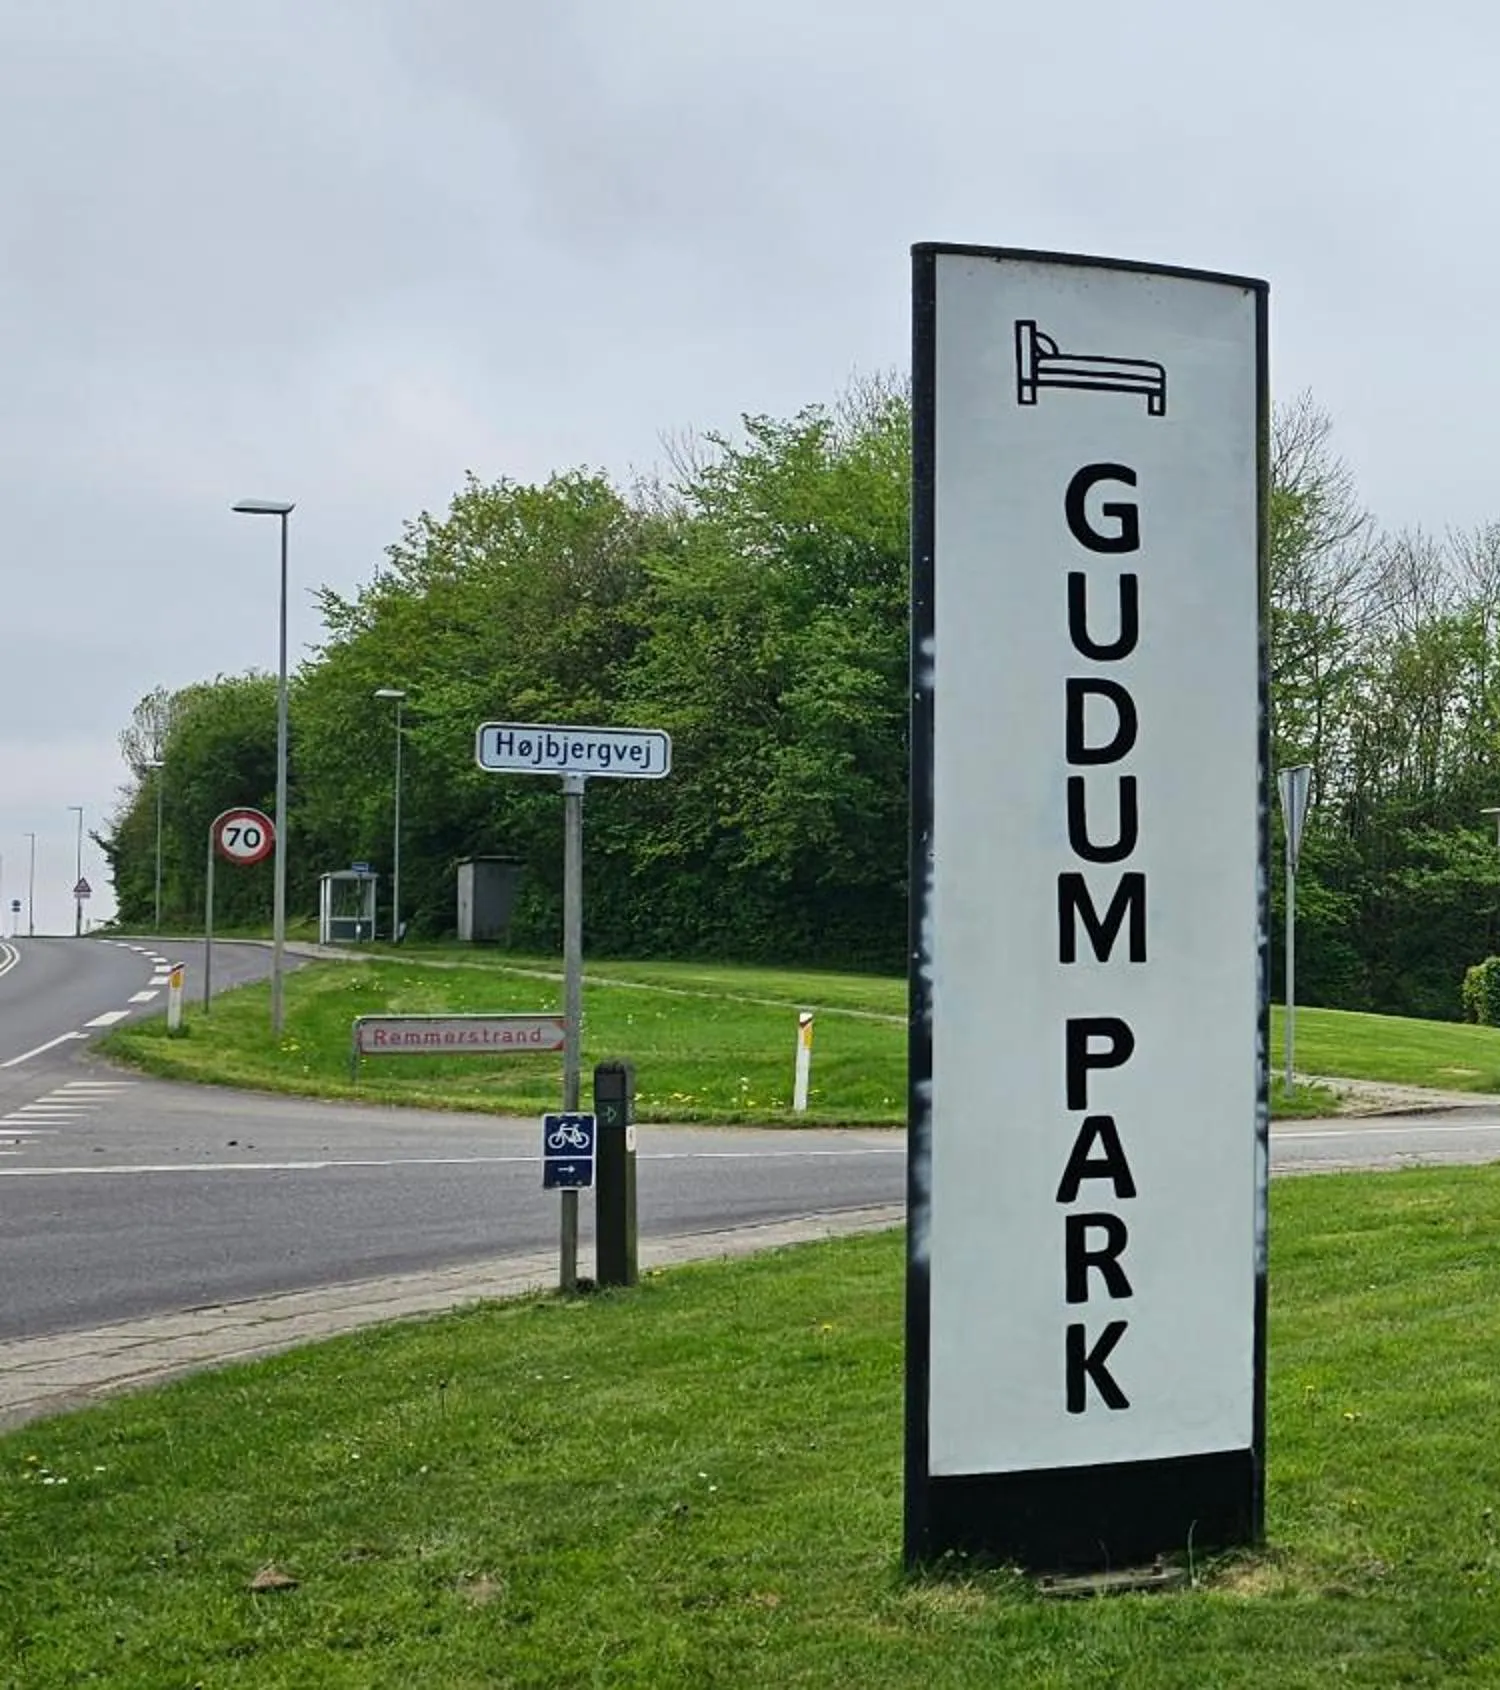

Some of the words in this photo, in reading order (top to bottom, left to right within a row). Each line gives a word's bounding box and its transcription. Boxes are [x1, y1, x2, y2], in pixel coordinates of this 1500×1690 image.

[495, 731, 651, 769] Højbjergvej
[1057, 462, 1147, 965] GUDUM
[226, 827, 261, 849] 70
[1055, 1017, 1137, 1415] PARK
